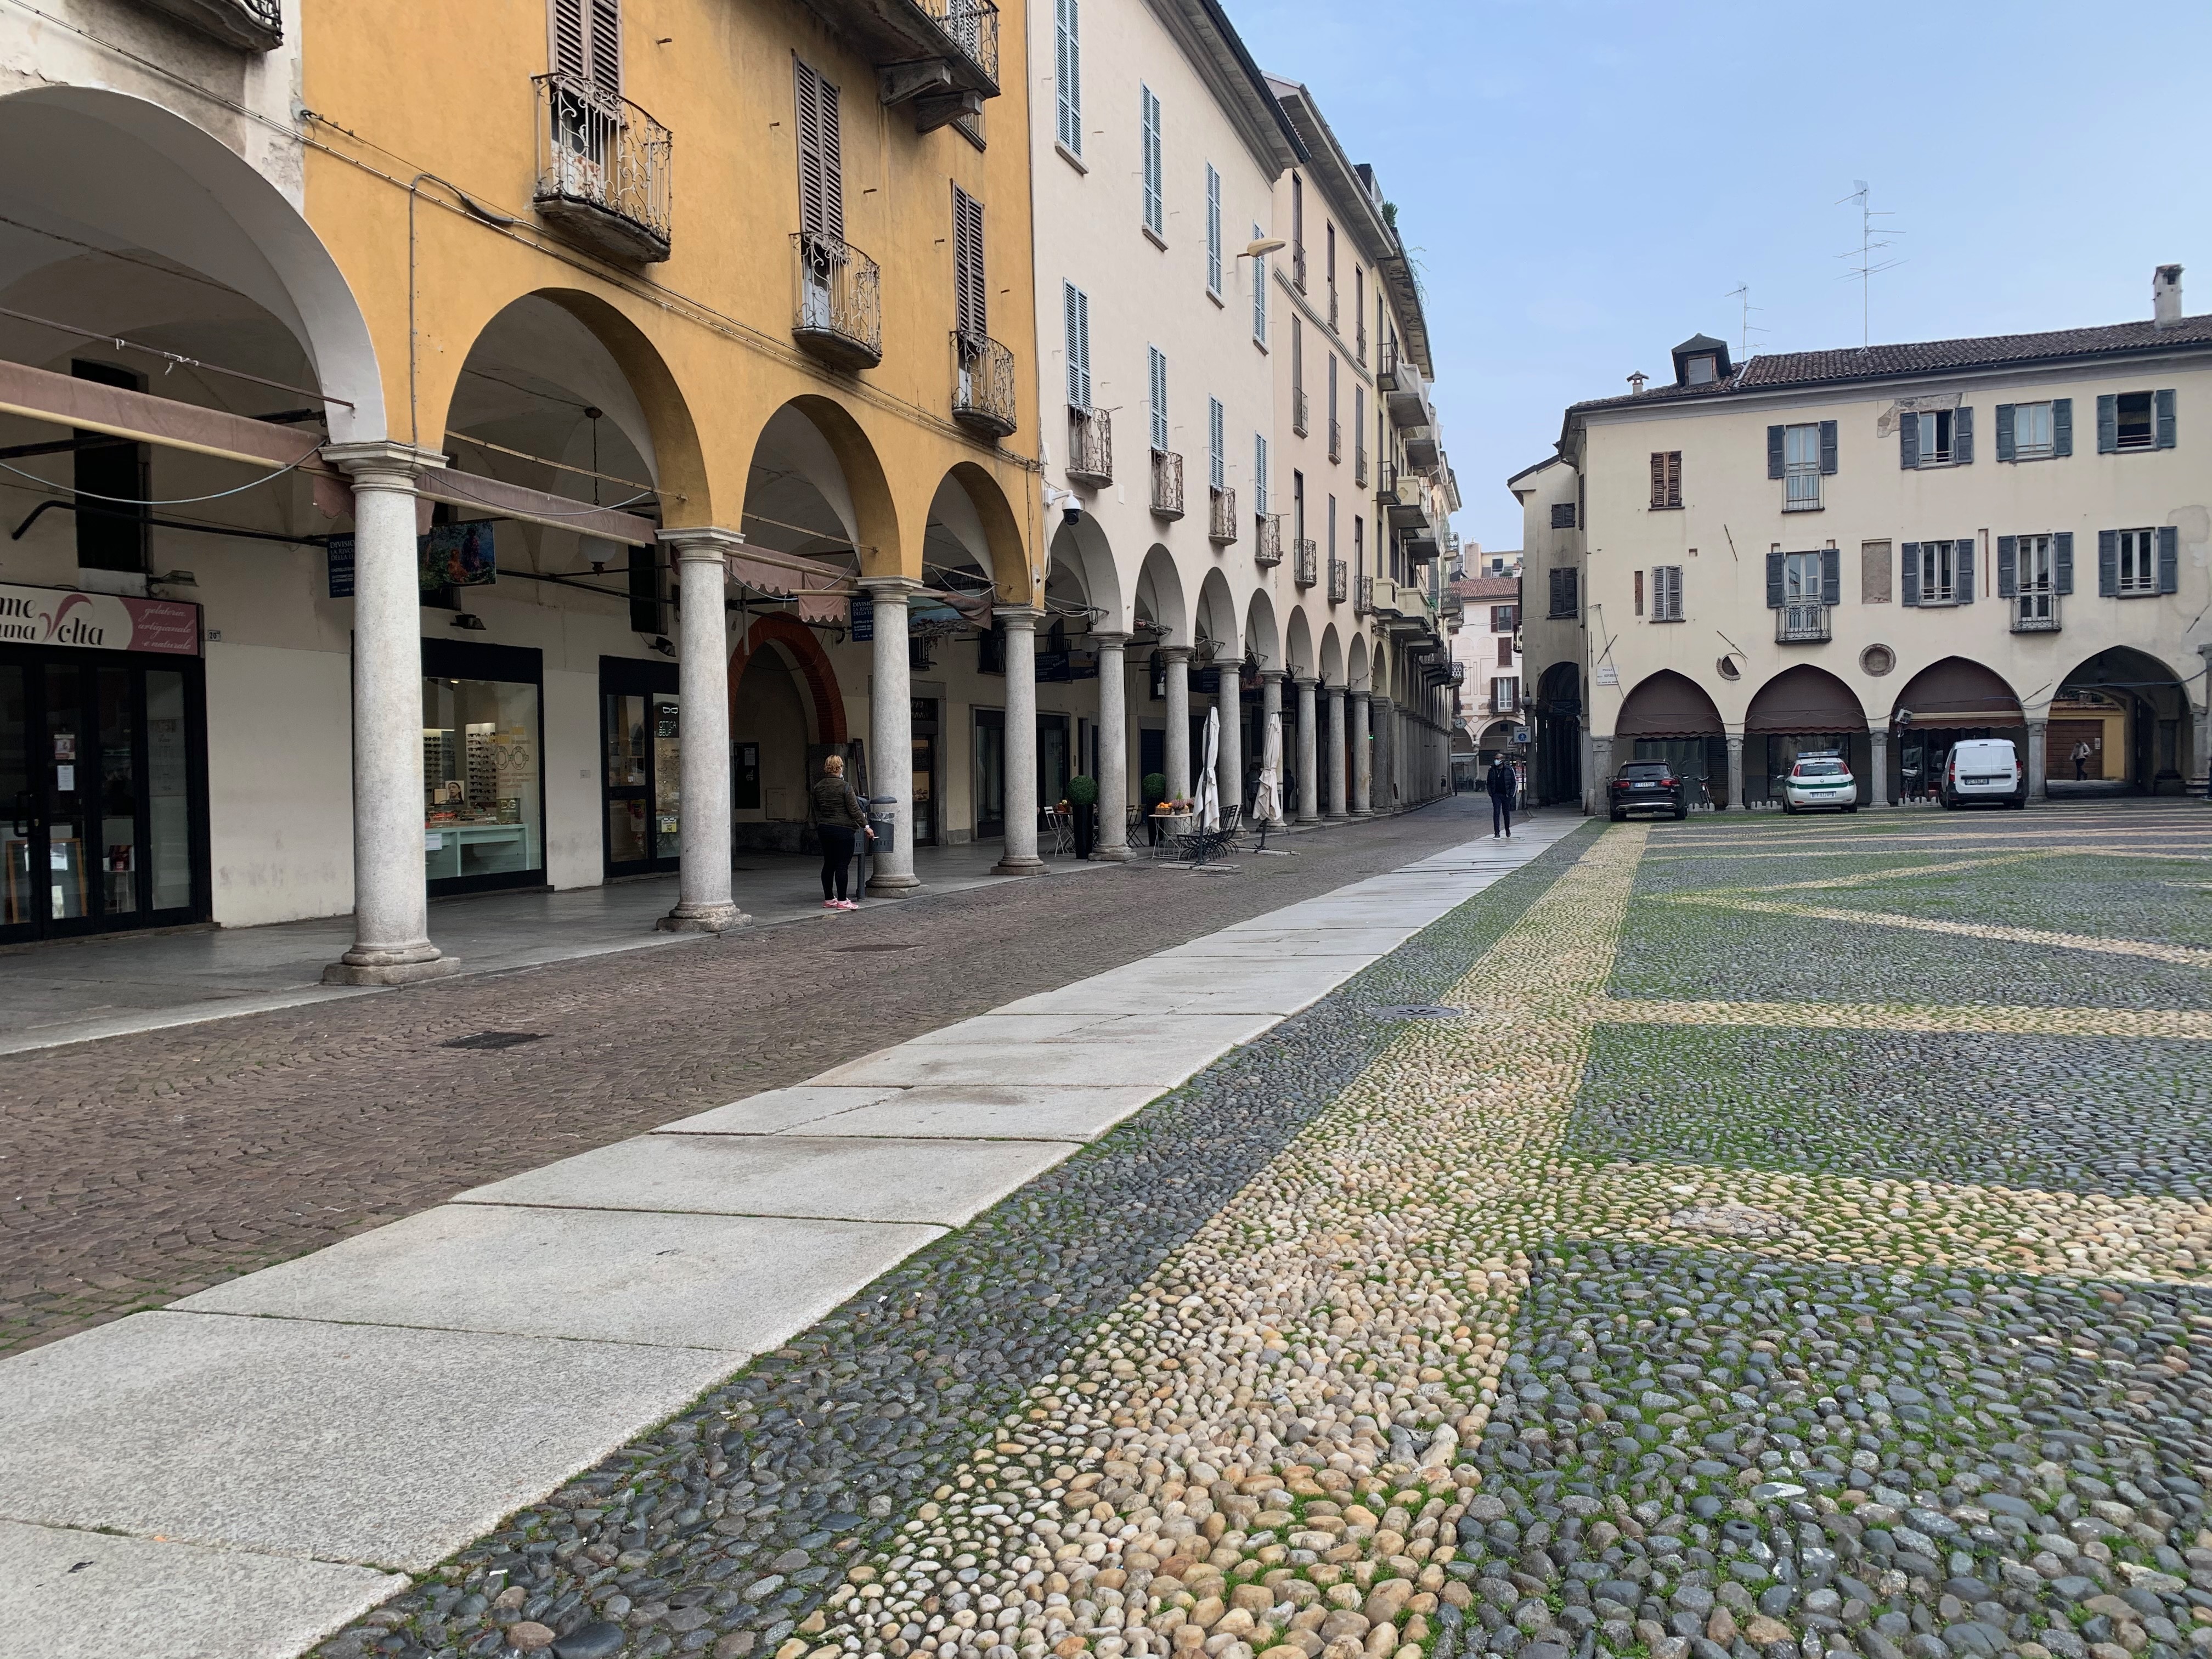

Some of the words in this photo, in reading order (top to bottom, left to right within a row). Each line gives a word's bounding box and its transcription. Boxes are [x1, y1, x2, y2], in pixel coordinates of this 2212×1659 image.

[38, 594, 105, 646] Volta
[138, 619, 194, 640] artigianale
[151, 636, 194, 650] naturale
[659, 720, 677, 729] OTTICA
